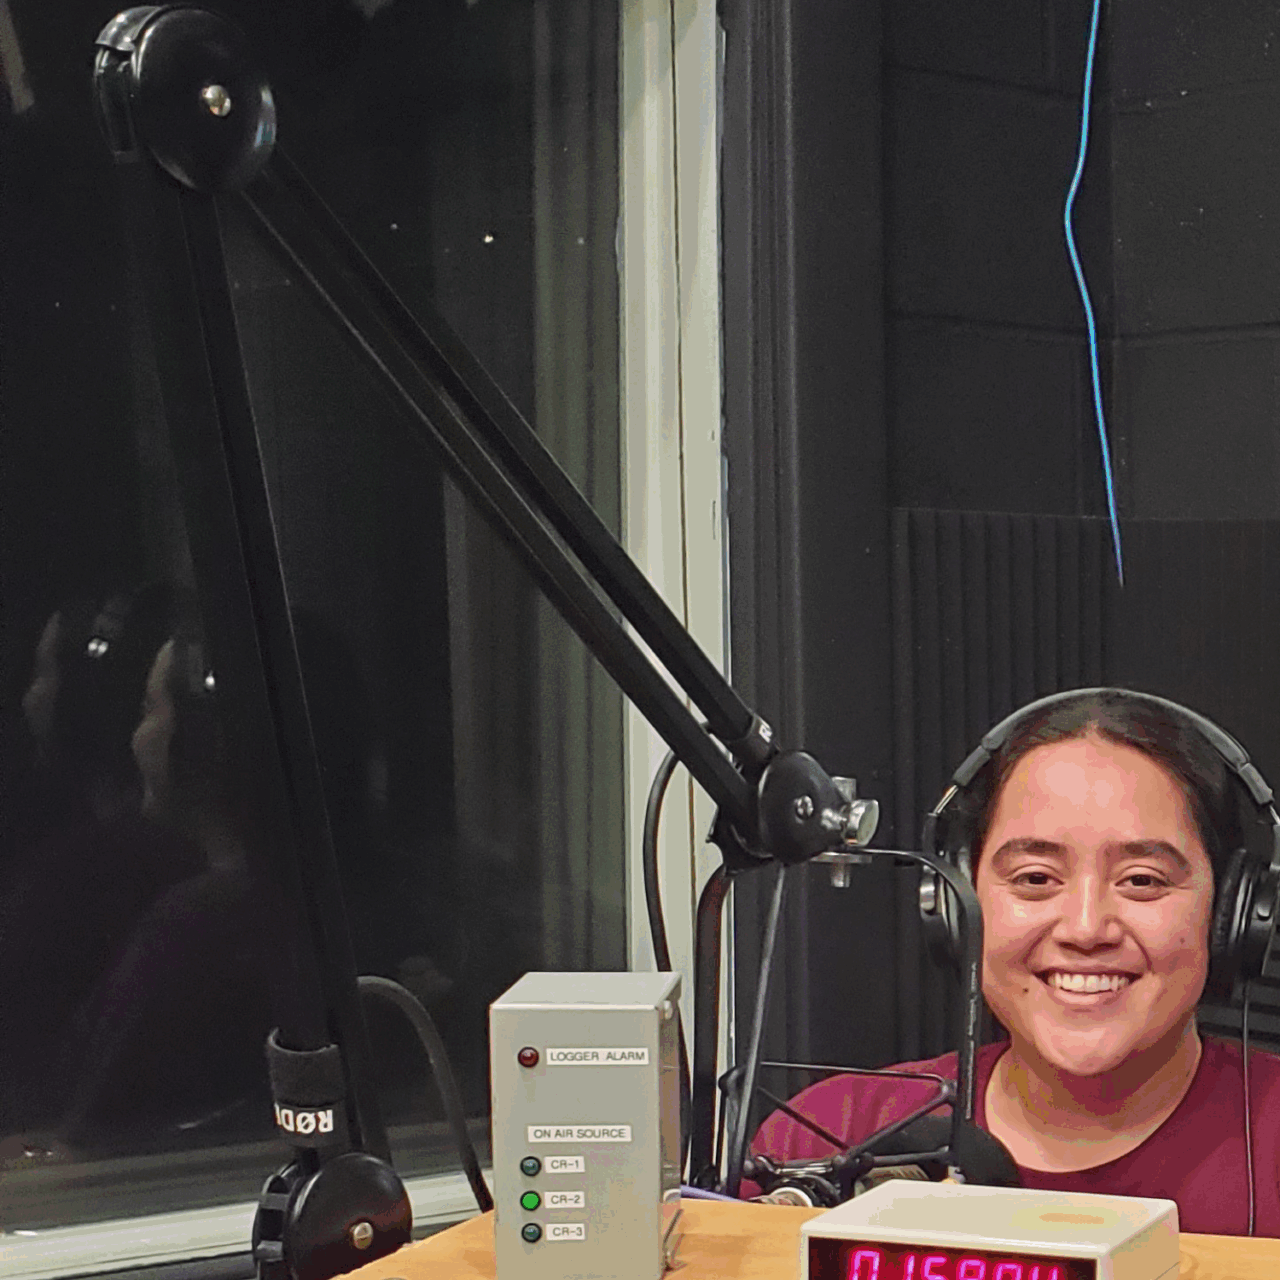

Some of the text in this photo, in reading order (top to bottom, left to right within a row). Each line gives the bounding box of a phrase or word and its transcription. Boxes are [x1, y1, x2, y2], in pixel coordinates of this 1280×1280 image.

[550, 1051, 645, 1062] LOGGER ALARM
[274, 1101, 334, 1134] RØD
[533, 1128, 626, 1139] ON AIR SOURCE
[550, 1160, 579, 1170] CR-1
[550, 1195, 581, 1205] CR-2
[552, 1227, 583, 1237] CR-3
